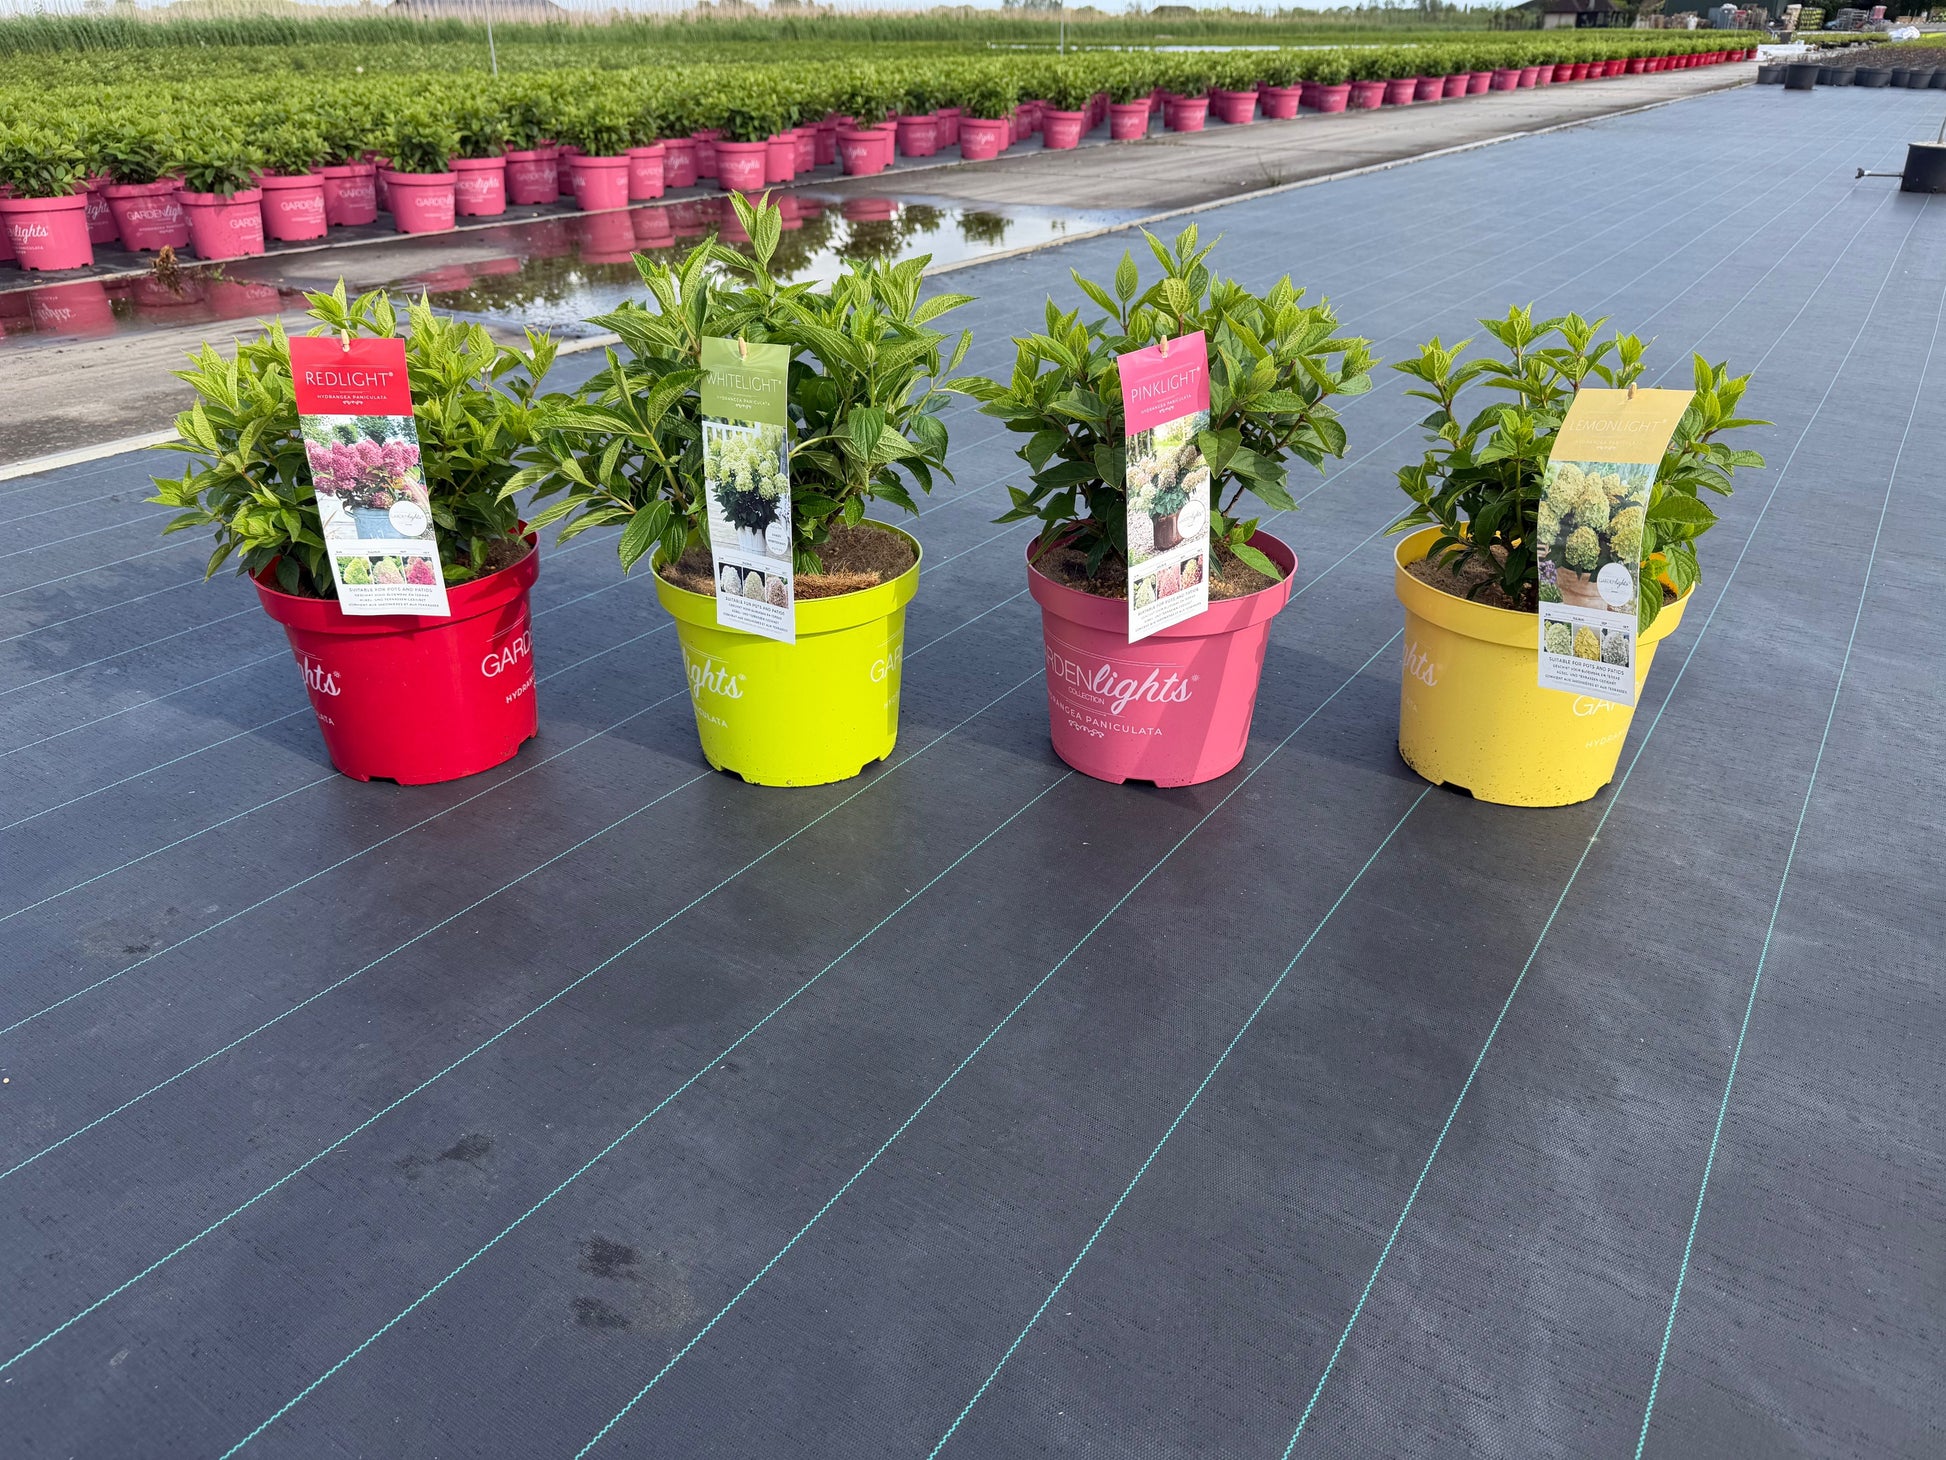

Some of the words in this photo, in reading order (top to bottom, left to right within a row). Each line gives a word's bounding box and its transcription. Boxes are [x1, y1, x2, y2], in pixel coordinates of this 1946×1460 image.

[1549, 657, 1570, 665] SUITABLE
[1067, 686, 1105, 705] COLLECTION
[1085, 714, 1163, 737] PANICULATA
